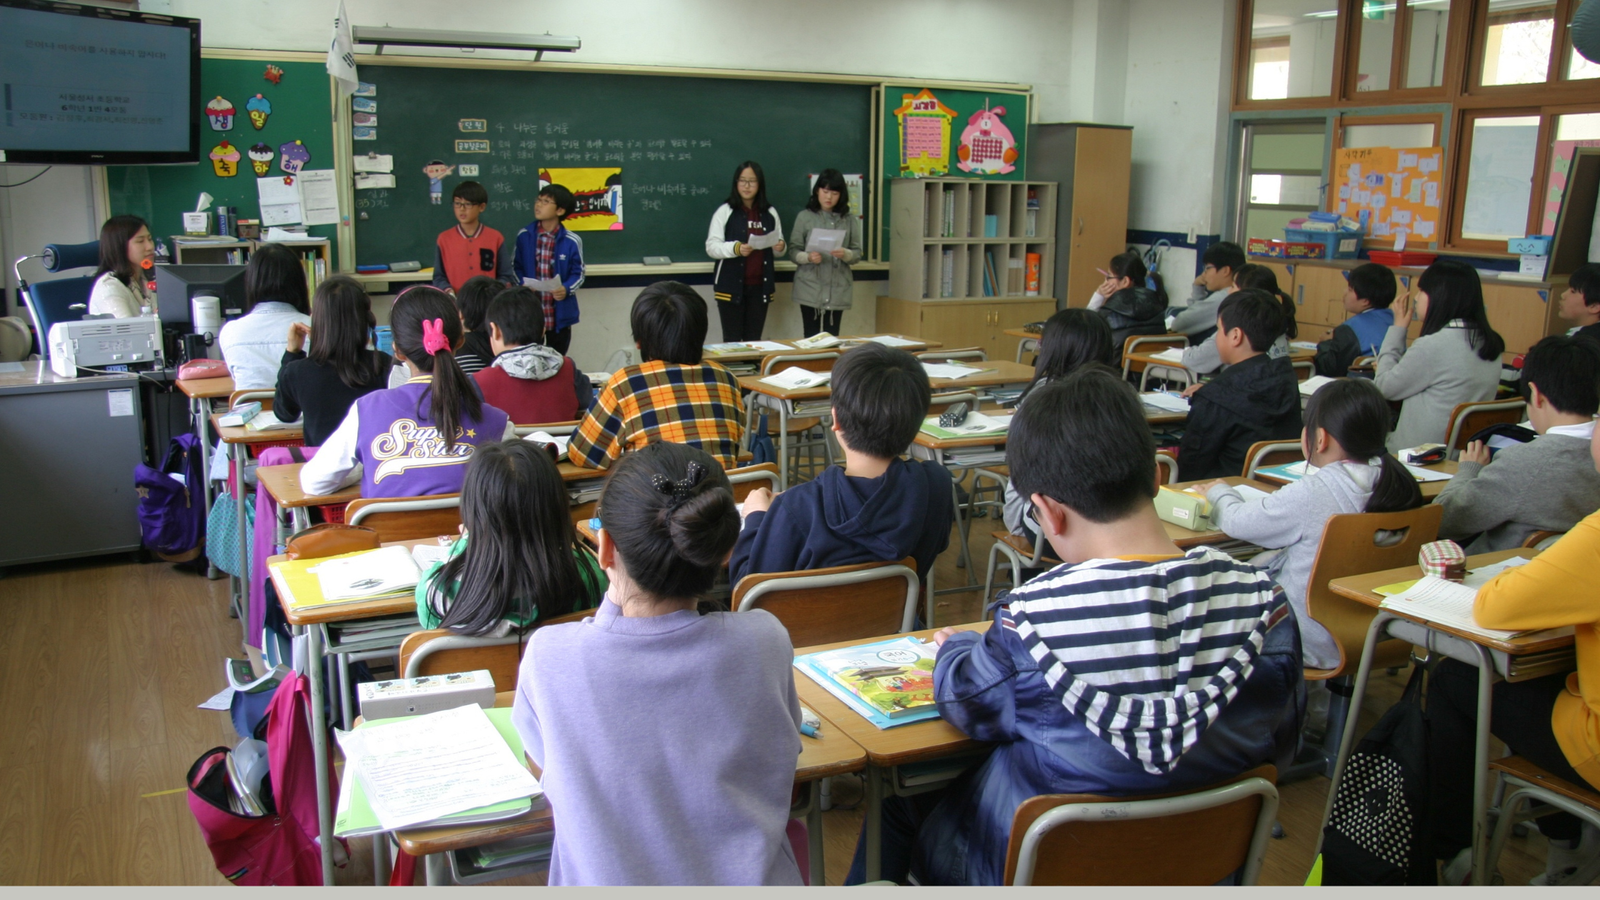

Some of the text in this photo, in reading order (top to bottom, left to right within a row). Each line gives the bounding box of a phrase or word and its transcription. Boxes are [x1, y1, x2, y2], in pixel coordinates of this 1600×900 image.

[251, 111, 266, 127] 일
[254, 161, 270, 173] 하
[283, 158, 299, 173] 해
